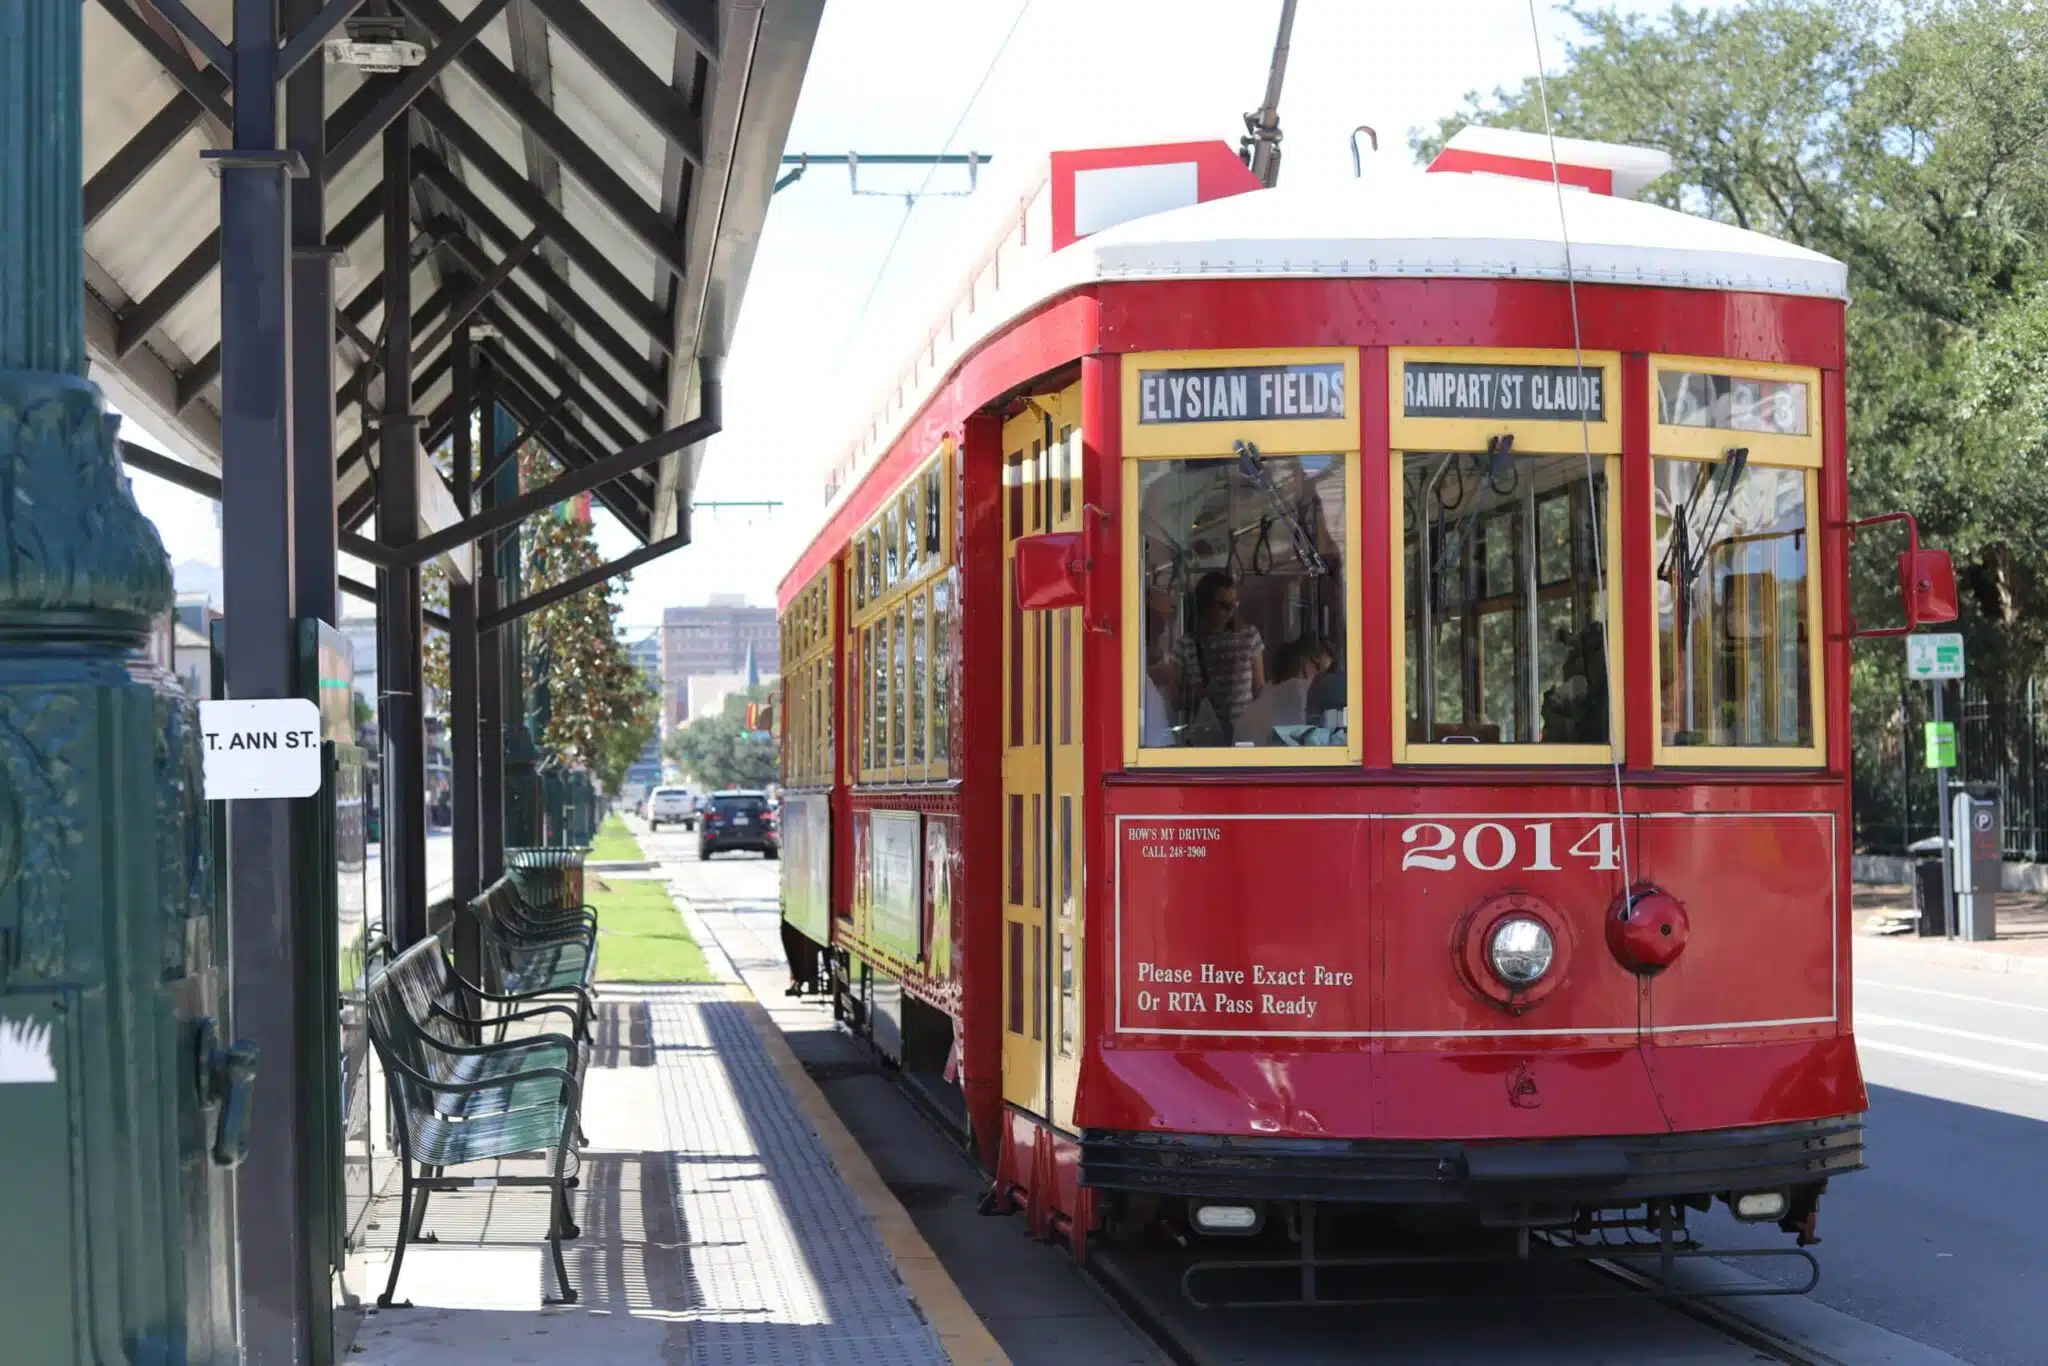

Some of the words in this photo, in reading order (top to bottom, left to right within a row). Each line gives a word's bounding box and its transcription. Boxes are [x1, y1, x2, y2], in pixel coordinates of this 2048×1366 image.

[1143, 375, 1247, 420] ELYSIAN
[1260, 371, 1345, 416] FIELDS
[1531, 375, 1600, 411] CLAUDE
[203, 733, 222, 750] T.
[229, 731, 277, 750] ANN
[285, 730, 317, 749] ST.
[1128, 828, 1157, 841] HOW'S
[1160, 828, 1175, 841] MY
[1178, 828, 1221, 841] DRIVING
[1401, 822, 1621, 872] 2014
[1142, 845, 1167, 858] CALL
[1169, 845, 1206, 858] 248-3900
[1137, 962, 1192, 983] Please
[1200, 963, 1244, 985] Have
[1252, 965, 1305, 986] Exact
[1313, 965, 1353, 986] Fare
[1137, 991, 1160, 1012] Or
[1168, 992, 1207, 1012] RTA
[1215, 993, 1253, 1014] Pass
[1261, 994, 1318, 1018] Ready
